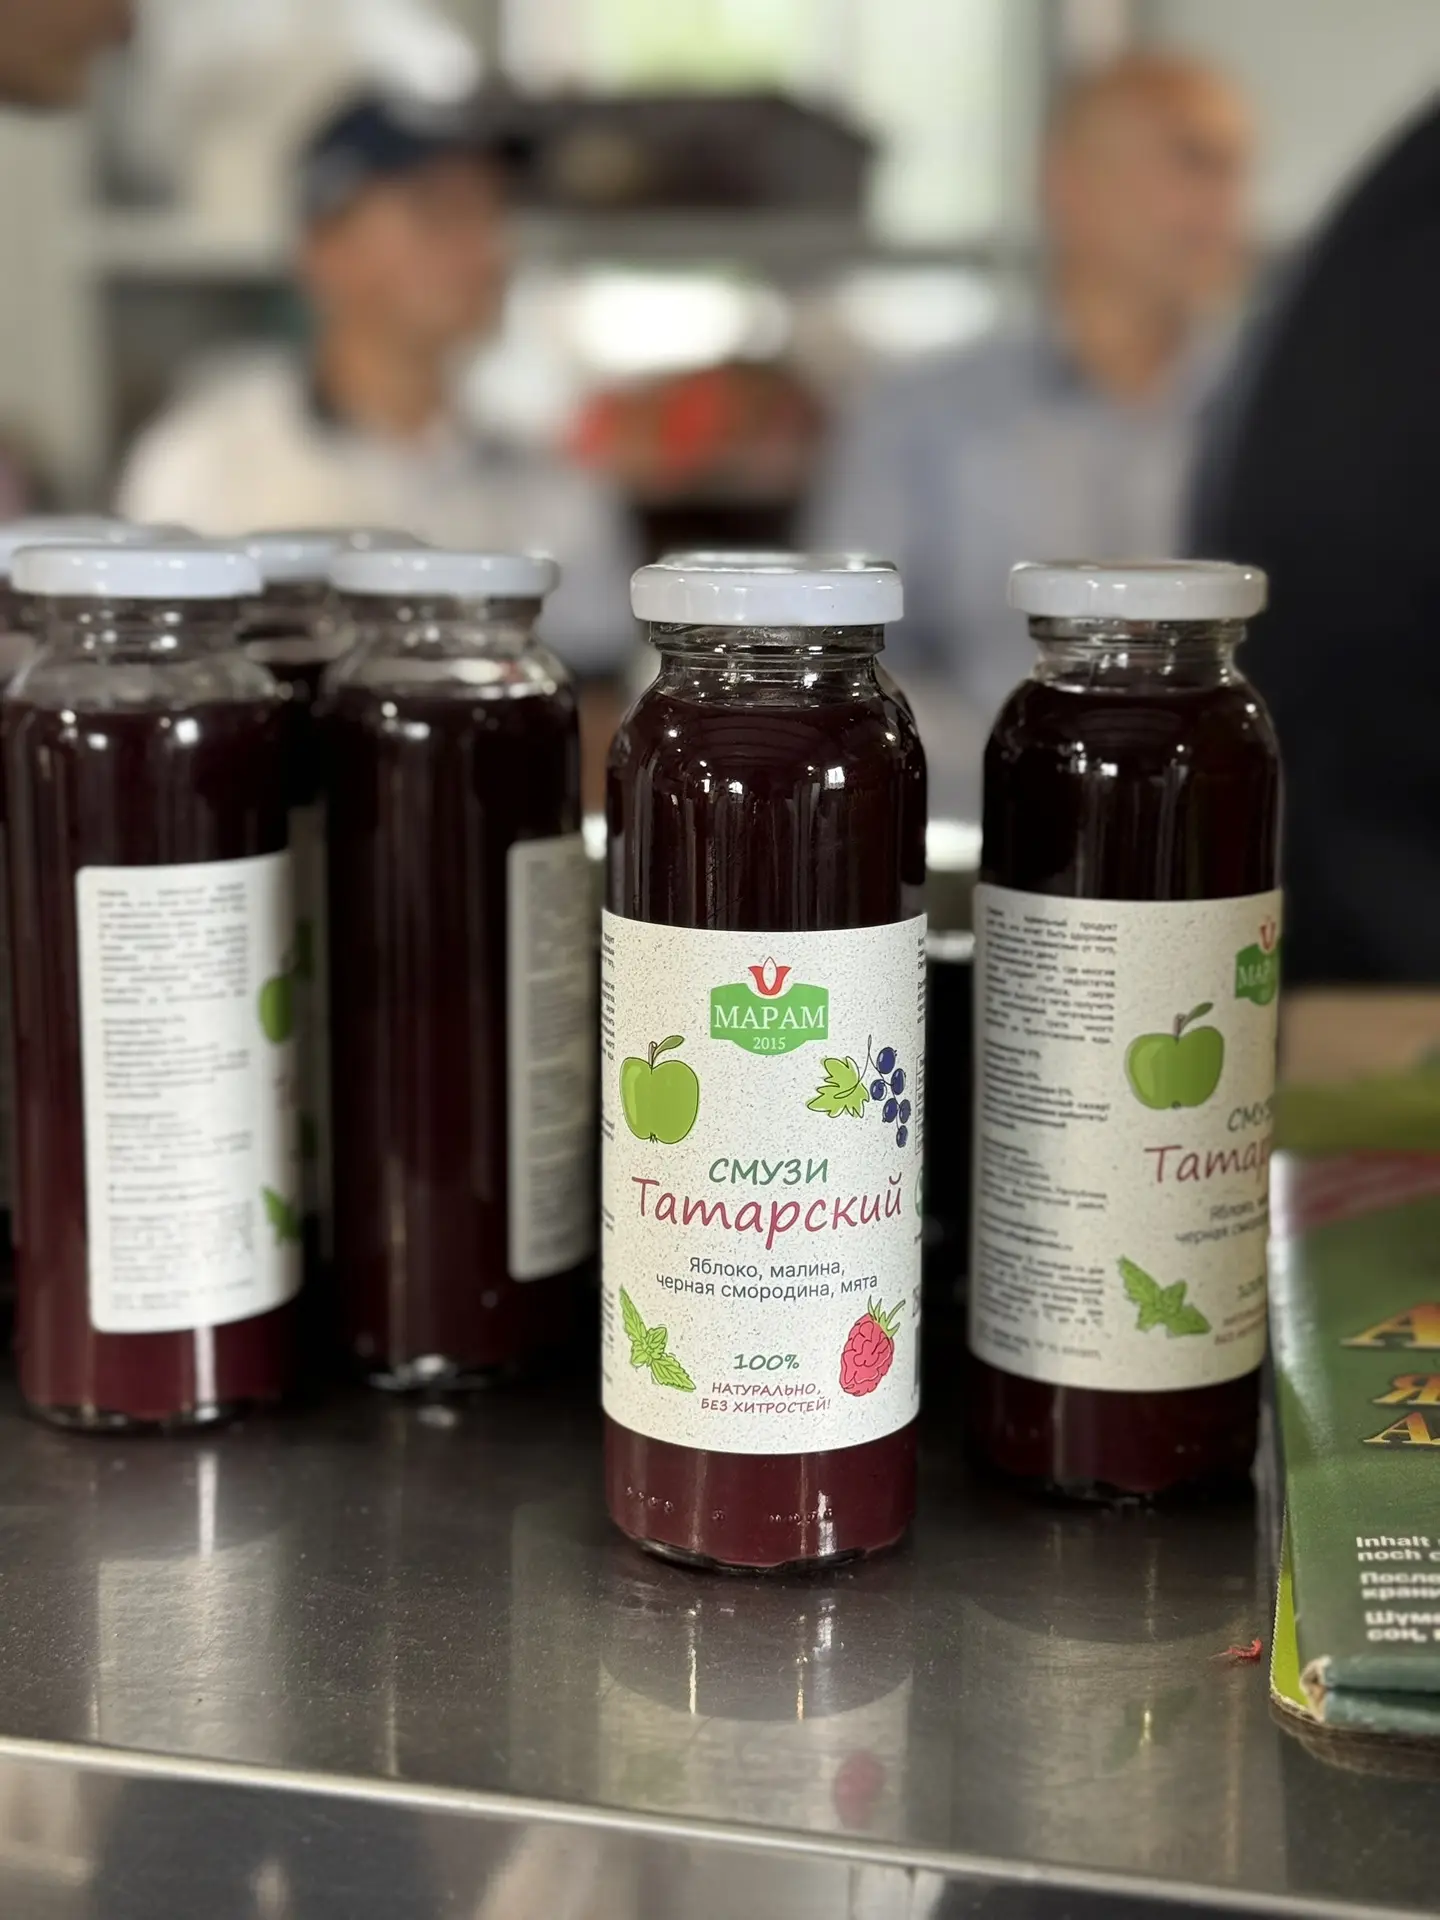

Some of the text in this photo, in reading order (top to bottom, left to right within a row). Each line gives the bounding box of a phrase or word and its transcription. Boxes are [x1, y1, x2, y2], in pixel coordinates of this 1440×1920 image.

[714, 1005, 825, 1029] МАРАМ
[753, 1037, 786, 1050] 2015
[631, 1172, 903, 1251] Татарский
[689, 1257, 846, 1280] Яблоко, малина,
[656, 1273, 878, 1303] черная смородина, мята
[733, 1353, 801, 1371] 100%
[711, 1382, 821, 1397] НАТУРАЛЬНО,
[701, 1398, 831, 1414] БЕЗ ХИТРОСТЕЙ!
[1356, 1535, 1431, 1548] Inhalt
